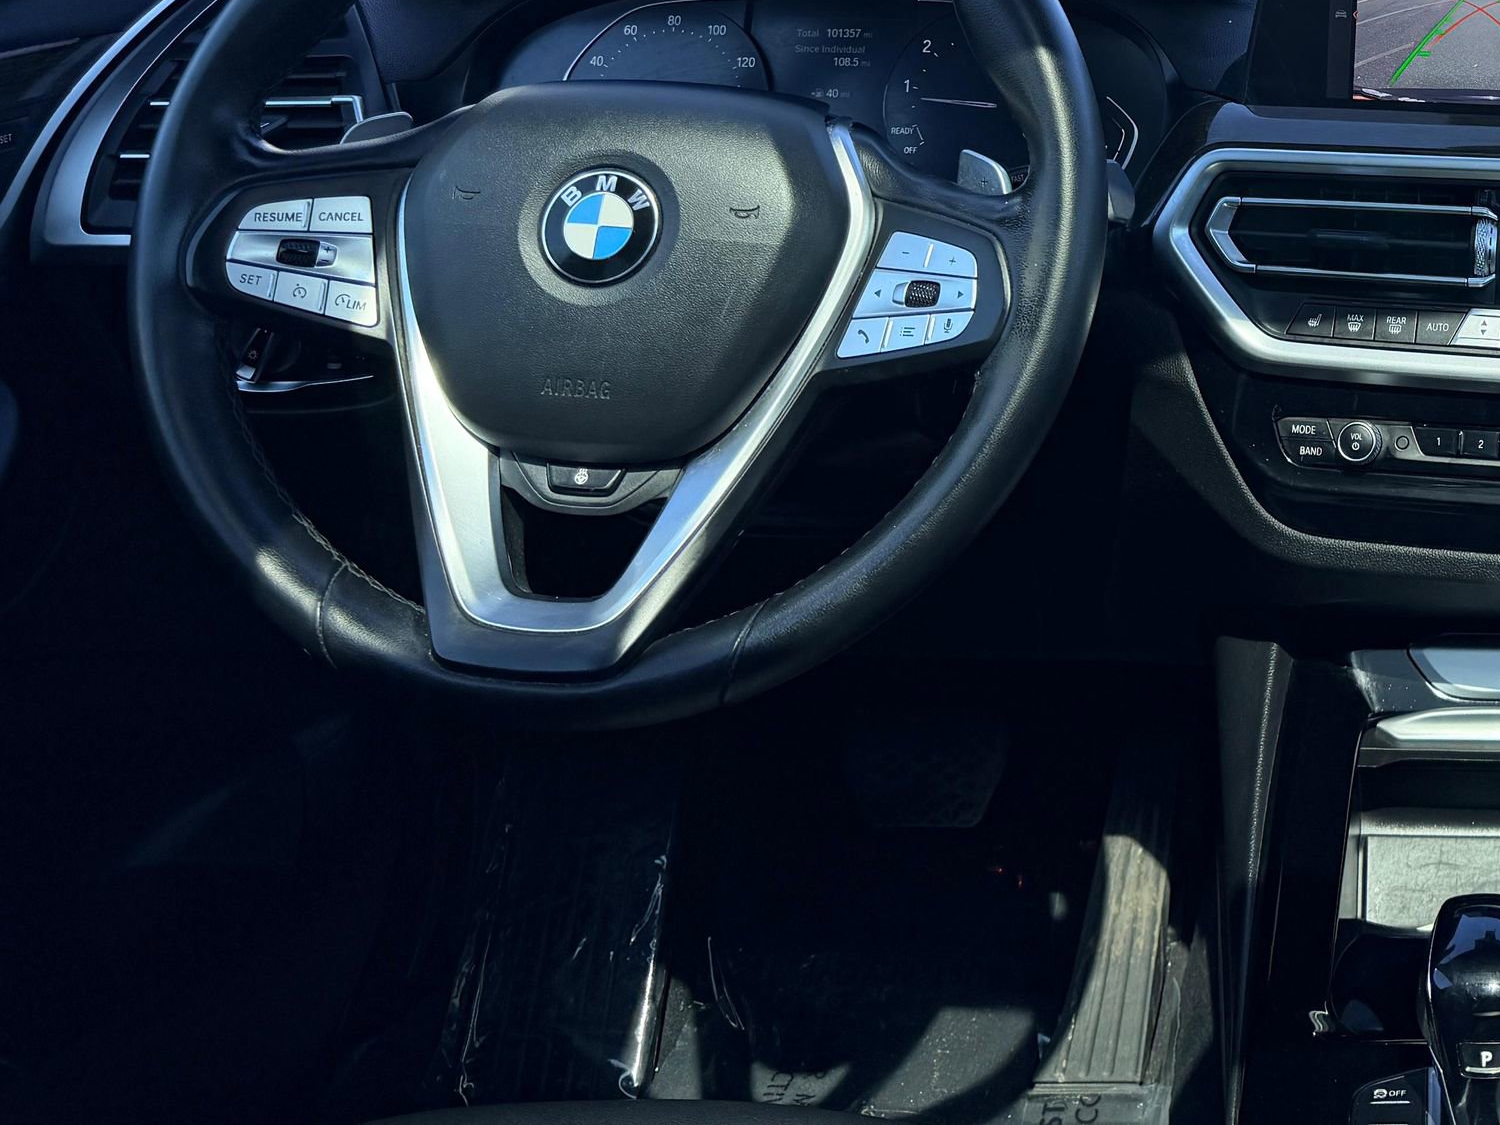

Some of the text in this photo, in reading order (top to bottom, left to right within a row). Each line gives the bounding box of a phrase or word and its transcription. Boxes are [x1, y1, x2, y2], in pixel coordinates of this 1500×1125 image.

[667, 15, 682, 26] 80
[623, 25, 727, 36] 60 100
[797, 28, 819, 38] Total
[827, 28, 862, 38] 101357
[794, 44, 866, 54] Since Individual
[922, 39, 932, 53] 2
[589, 55, 756, 68] 40 120
[833, 57, 860, 67] 108.5
[904, 79, 910, 93] 1
[825, 88, 839, 98] 40
[891, 127, 915, 135] READY
[903, 146, 918, 155] OFF
[561, 174, 650, 212] BMW
[254, 211, 303, 223] RESUME
[318, 211, 364, 222] CANCEL
[239, 273, 262, 286] SET
[346, 298, 367, 312] LIM
[1347, 313, 1364, 323] MAX
[1386, 316, 1407, 325] REAR
[1426, 322, 1450, 333] AUTO
[541, 377, 612, 400] AIRBAG
[1291, 424, 1317, 435] MODE
[1350, 433, 1363, 441] VOL
[1436, 437, 1442, 447] 1
[1478, 439, 1484, 449] 2
[1300, 445, 1323, 456] BAND
[1480, 1050, 1493, 1068] P
[1388, 1089, 1407, 1097] OFF
